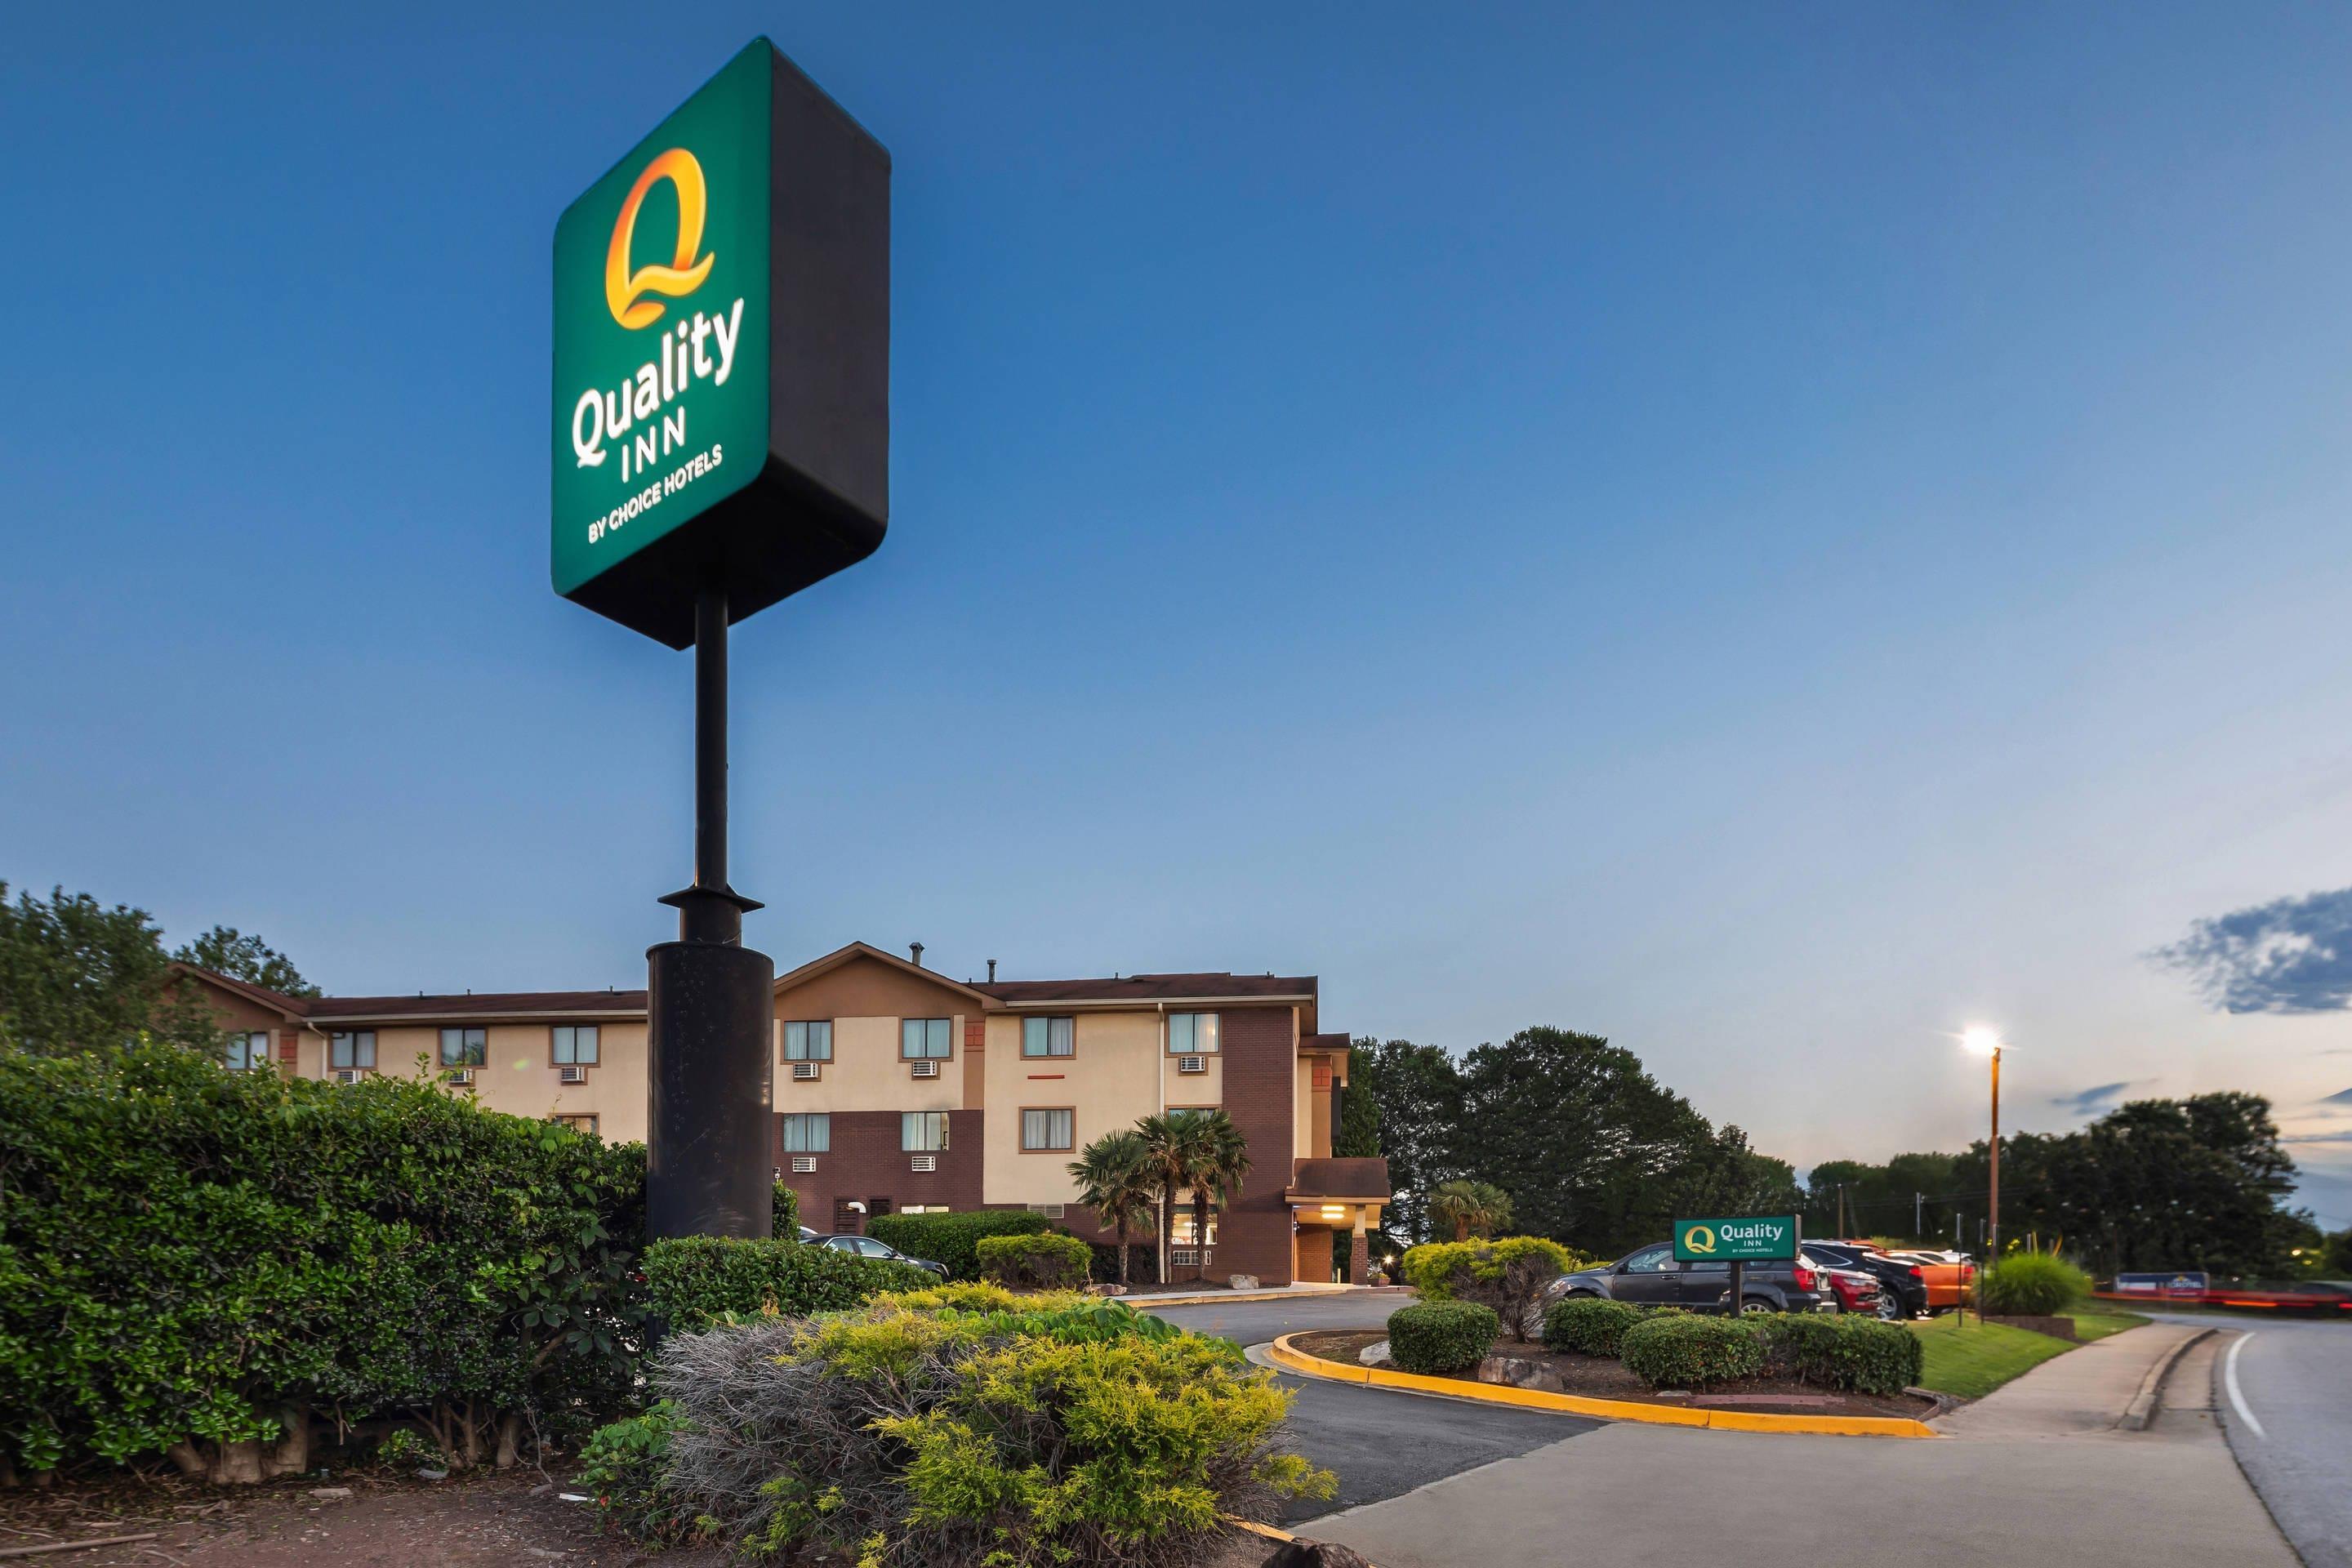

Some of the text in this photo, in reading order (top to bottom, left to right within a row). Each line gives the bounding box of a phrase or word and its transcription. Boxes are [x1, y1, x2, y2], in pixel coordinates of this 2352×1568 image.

[572, 297, 745, 468] Quality
[621, 406, 685, 483] INN
[588, 443, 723, 544] BY CHOICE HOTELS
[1720, 1223, 1784, 1241] Quality
